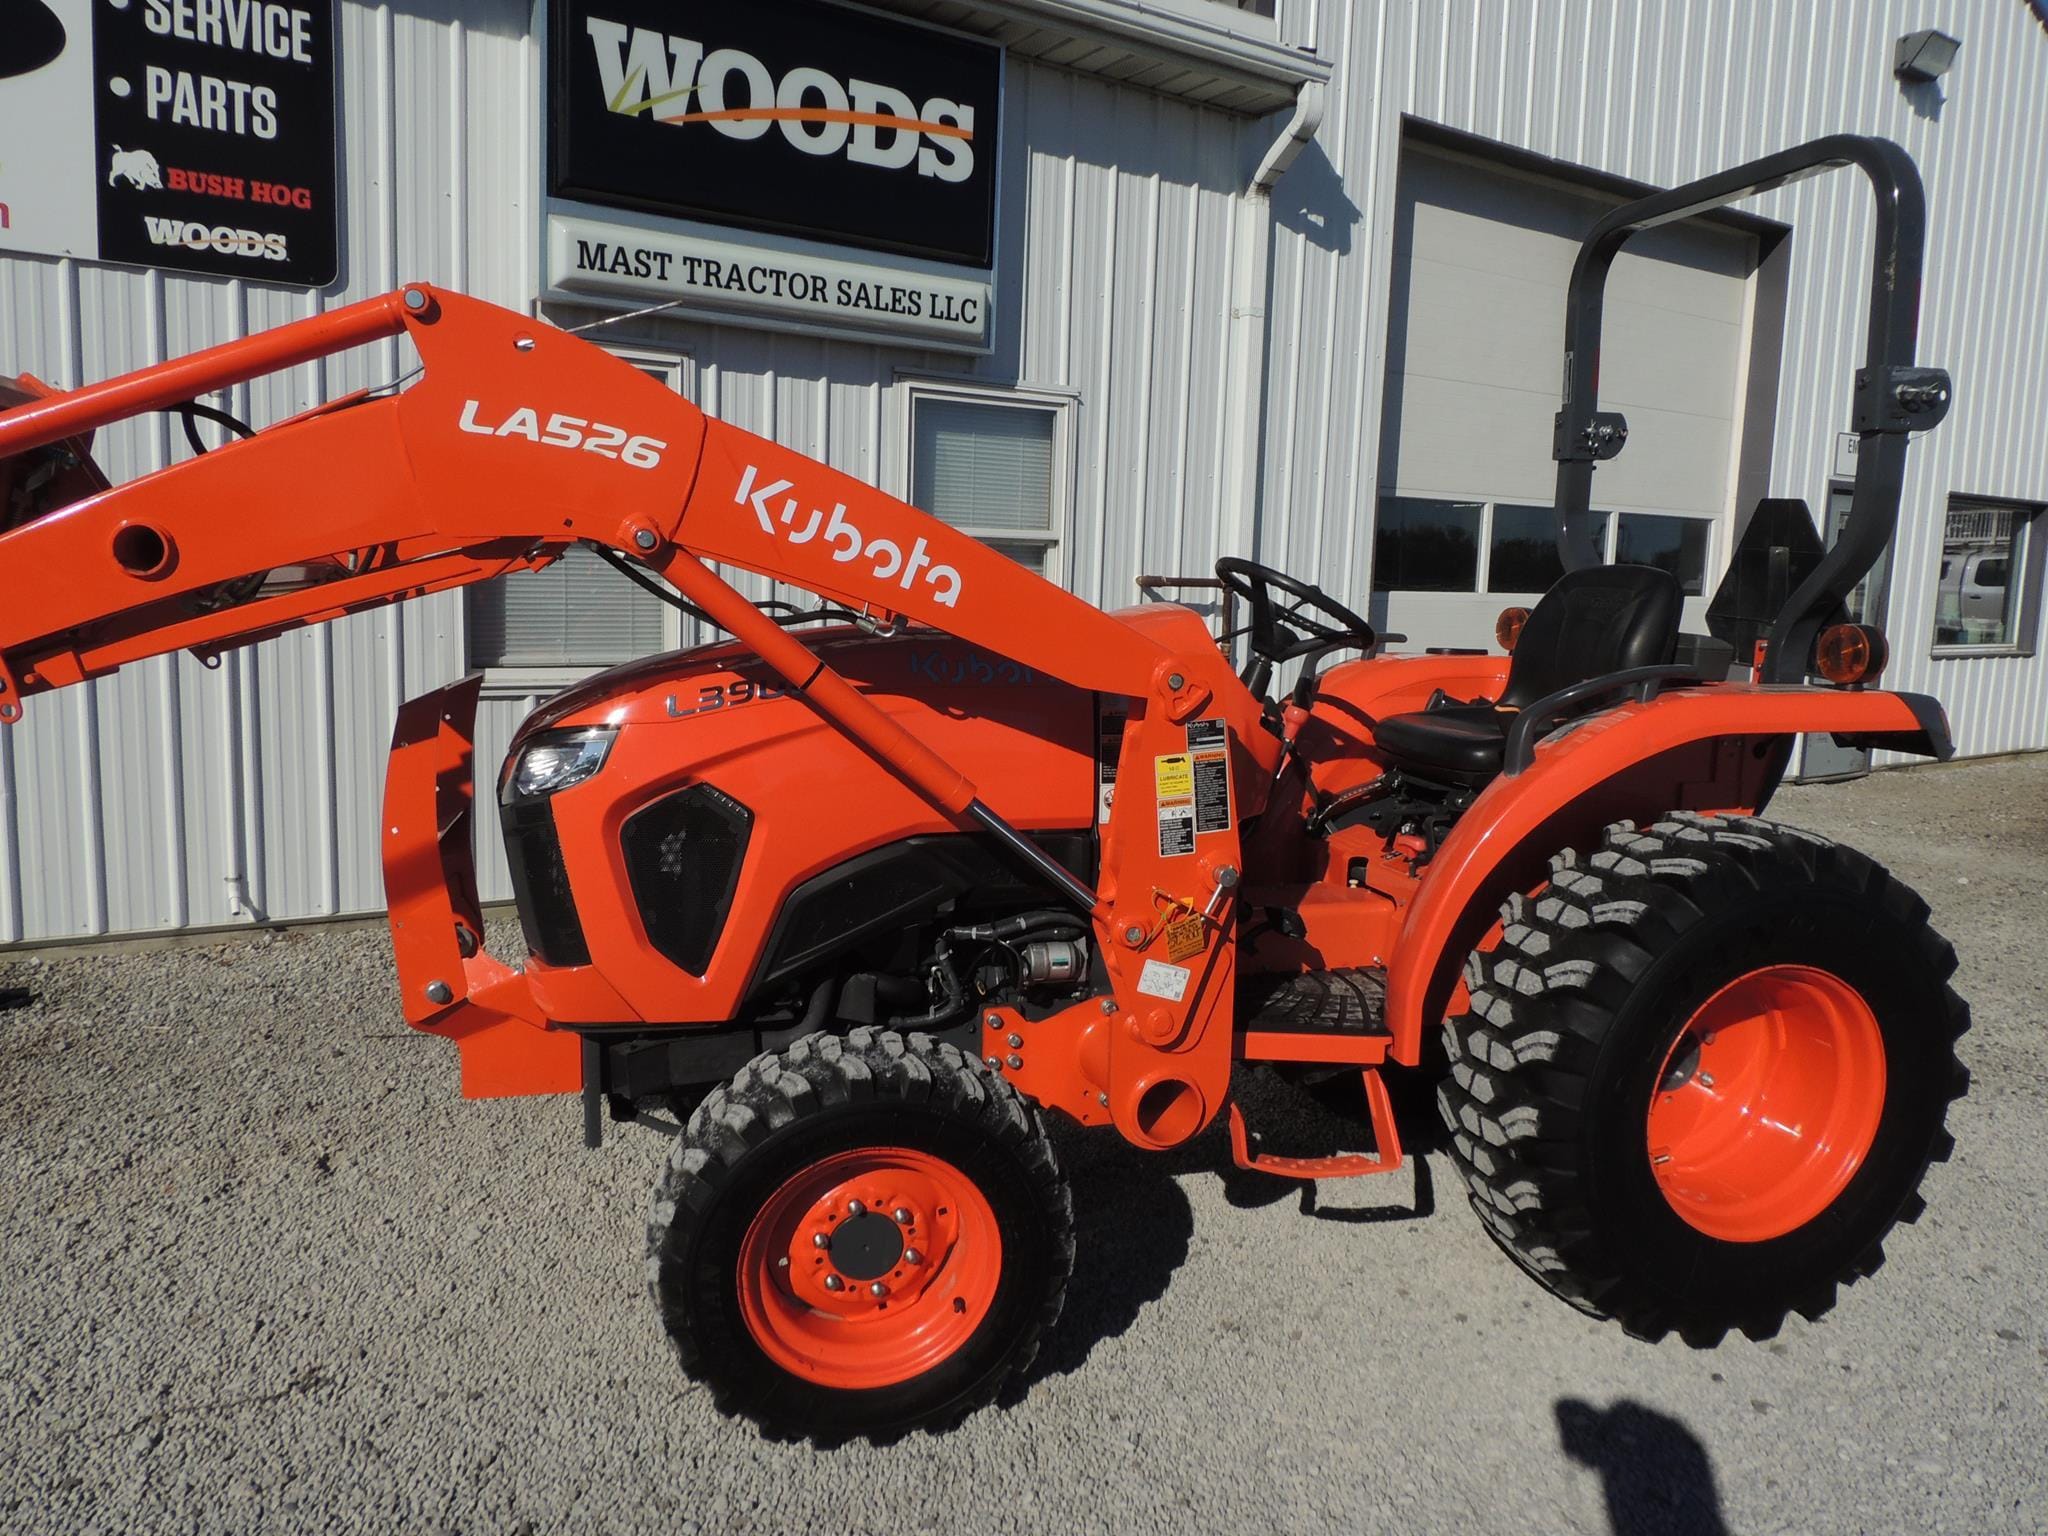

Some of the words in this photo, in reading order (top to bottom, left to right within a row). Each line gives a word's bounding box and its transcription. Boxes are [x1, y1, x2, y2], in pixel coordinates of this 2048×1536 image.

[144, 0, 312, 63] SERVICE
[146, 65, 278, 140] PARTS
[587, 16, 975, 183] WOODS
[167, 167, 244, 200] BUSH
[250, 181, 312, 210] HOG
[144, 216, 288, 261] WOODS
[577, 240, 672, 281] MAST
[682, 256, 828, 304] TRACTOR
[836, 279, 922, 317] SALES
[929, 293, 978, 325] LLC
[458, 399, 668, 470] LA526
[733, 464, 963, 609] Kubota
